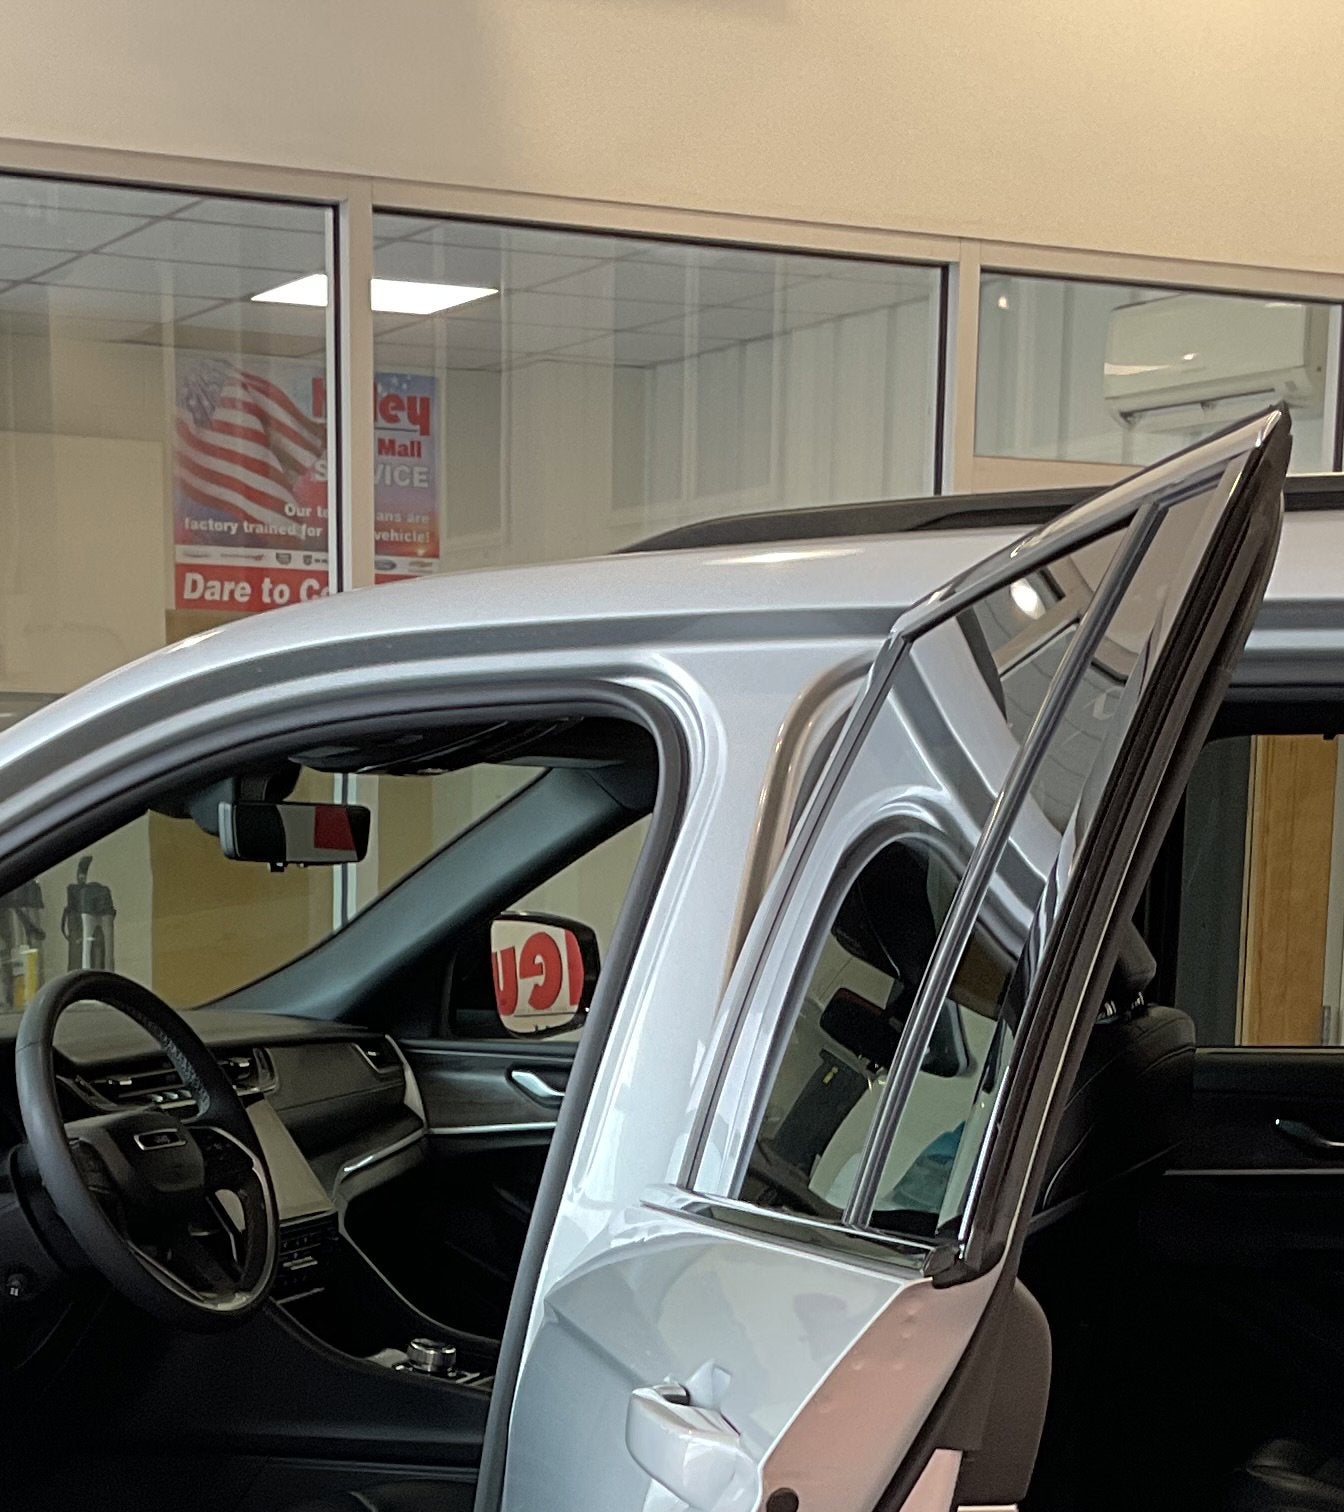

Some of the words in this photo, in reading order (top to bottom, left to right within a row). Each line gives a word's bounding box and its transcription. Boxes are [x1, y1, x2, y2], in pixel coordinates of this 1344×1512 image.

[377, 438, 422, 458] Mall
[284, 503, 312, 517] Our
[184, 517, 238, 534] factory
[244, 519, 296, 535] trained
[301, 523, 323, 539] for
[183, 572, 251, 602] Dare
[261, 577, 290, 605] to
